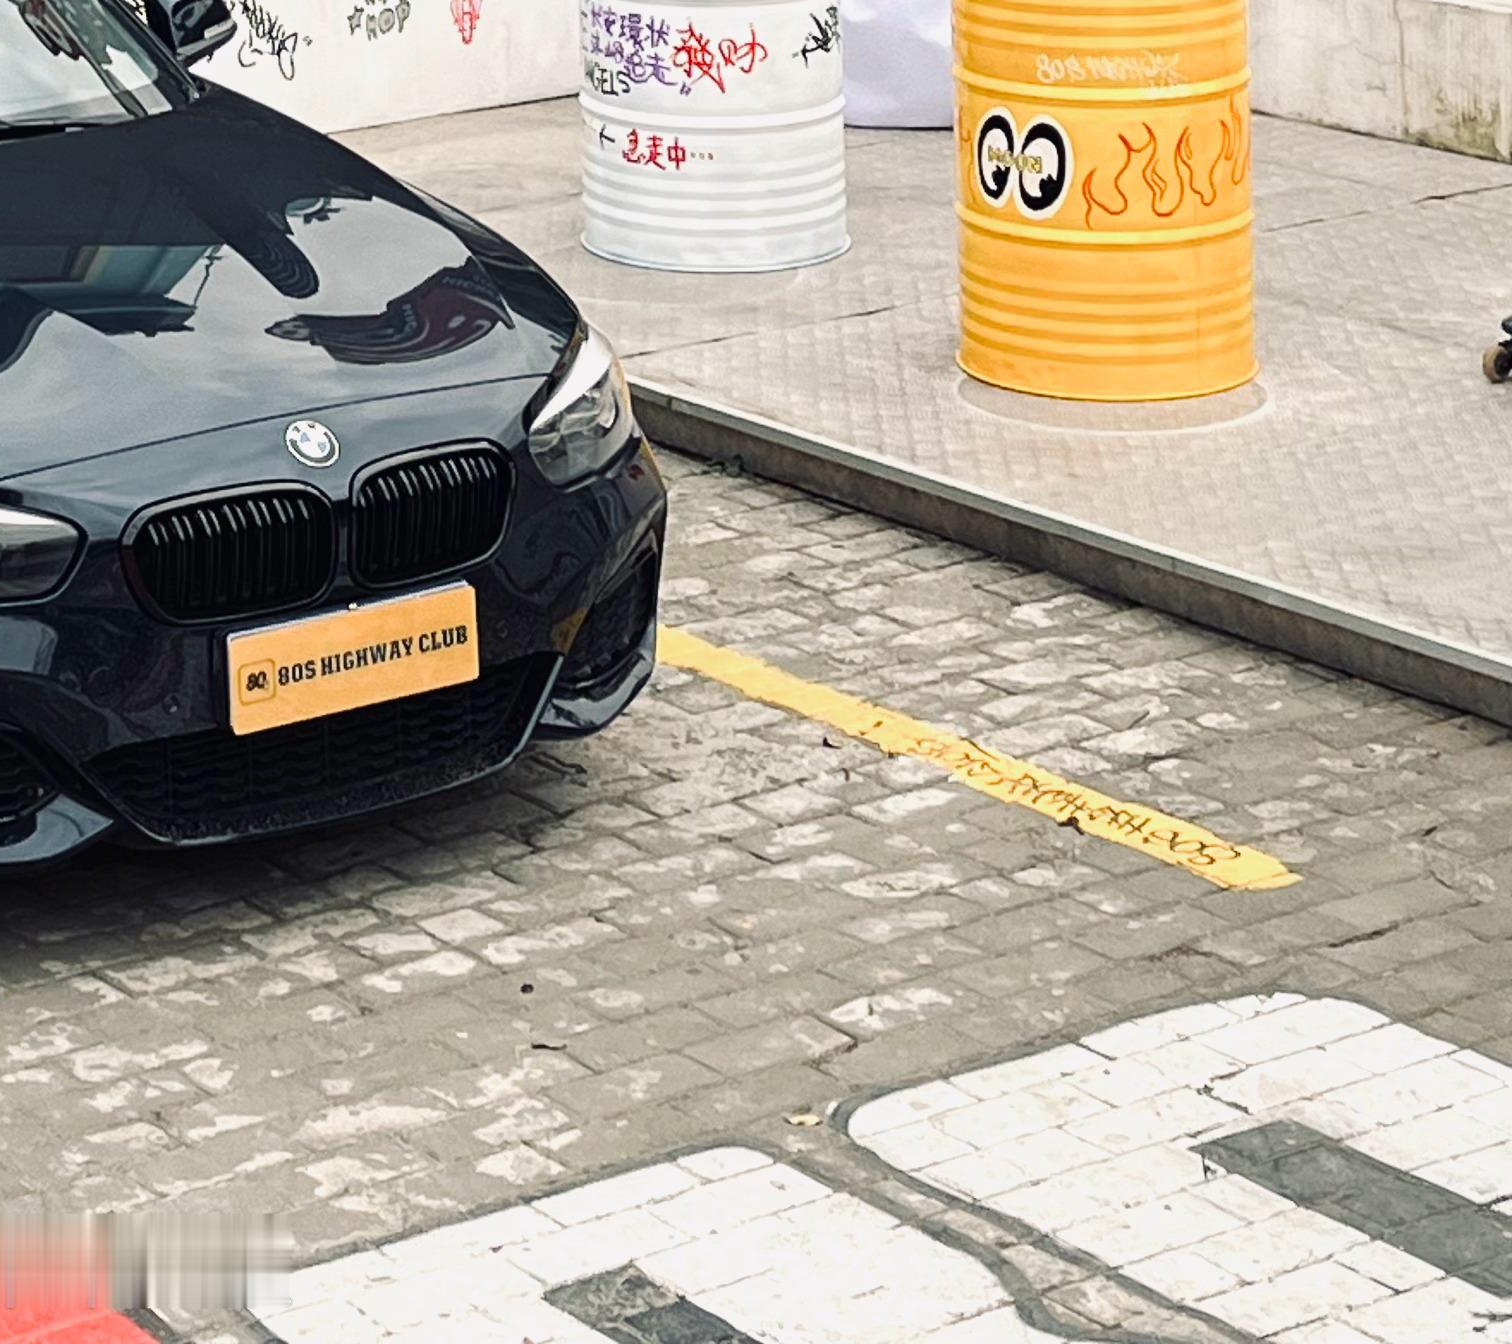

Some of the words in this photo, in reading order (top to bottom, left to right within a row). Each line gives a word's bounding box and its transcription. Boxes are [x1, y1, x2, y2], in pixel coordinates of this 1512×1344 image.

[278, 658, 317, 687] 80S
[320, 635, 414, 677] HIGHWAY
[418, 624, 468, 654] CLUB
